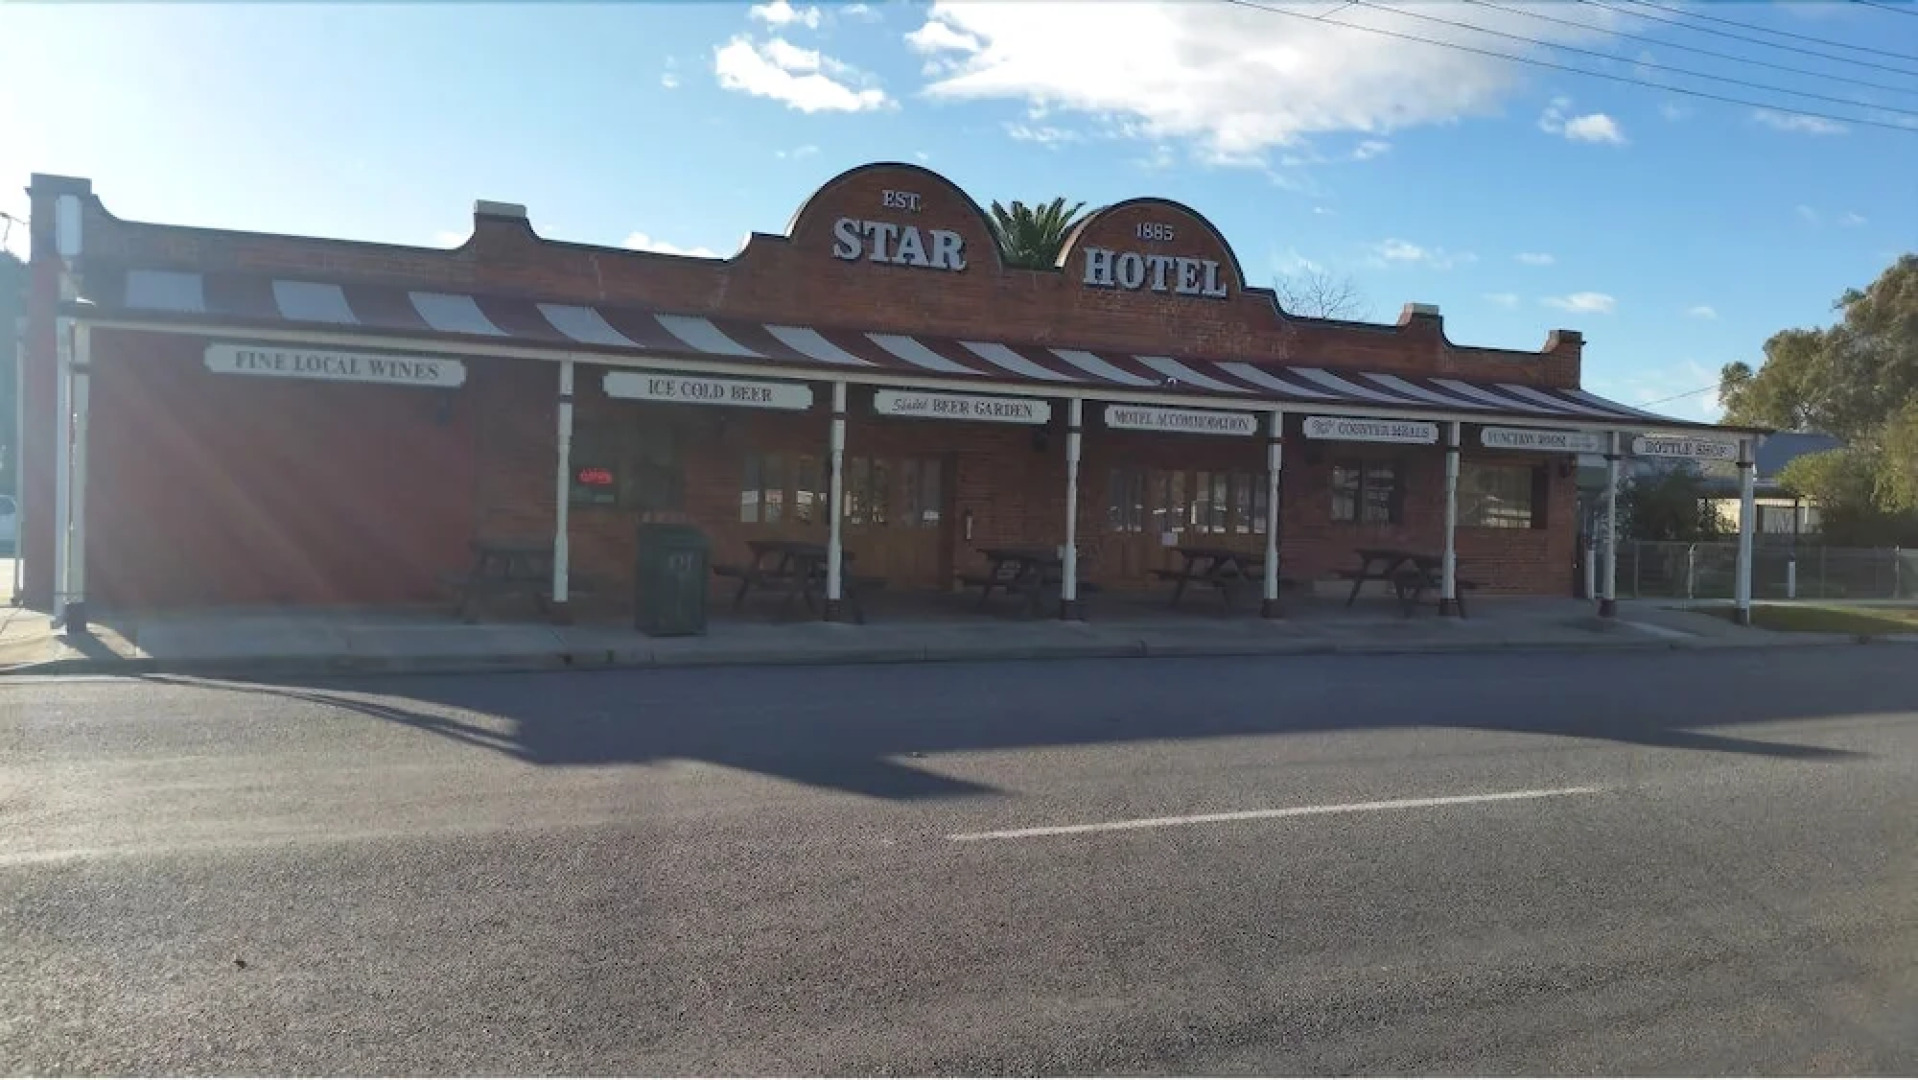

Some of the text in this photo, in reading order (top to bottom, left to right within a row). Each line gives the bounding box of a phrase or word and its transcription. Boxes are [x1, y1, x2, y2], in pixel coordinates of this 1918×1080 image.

[882, 190, 921, 211] EST.
[1137, 222, 1175, 241] 1885
[833, 217, 968, 271] STAR
[1083, 248, 1228, 298] HOTEL
[235, 350, 440, 380] FINE LOCAL WINES
[648, 378, 773, 402] ICE COLD BEER
[933, 399, 970, 415] BEER
[976, 402, 1033, 418] GARDEN
[1645, 440, 1692, 454] BOTTLE
